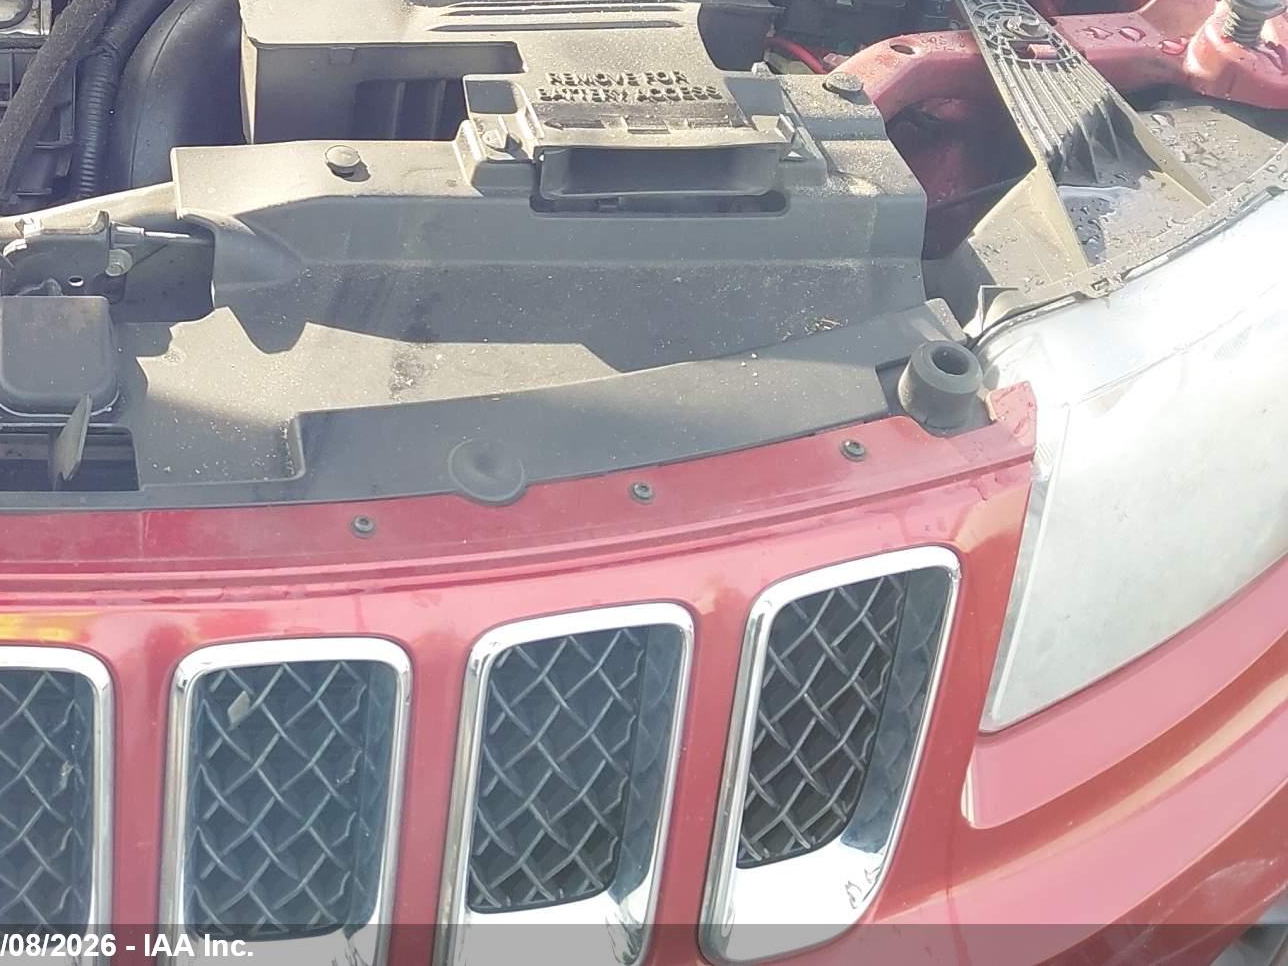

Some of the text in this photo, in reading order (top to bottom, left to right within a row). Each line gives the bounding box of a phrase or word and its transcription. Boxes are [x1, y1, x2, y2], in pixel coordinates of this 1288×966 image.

[547, 69, 690, 87] REMOVE FOR
[537, 85, 723, 104] BATTERY ACCESS
